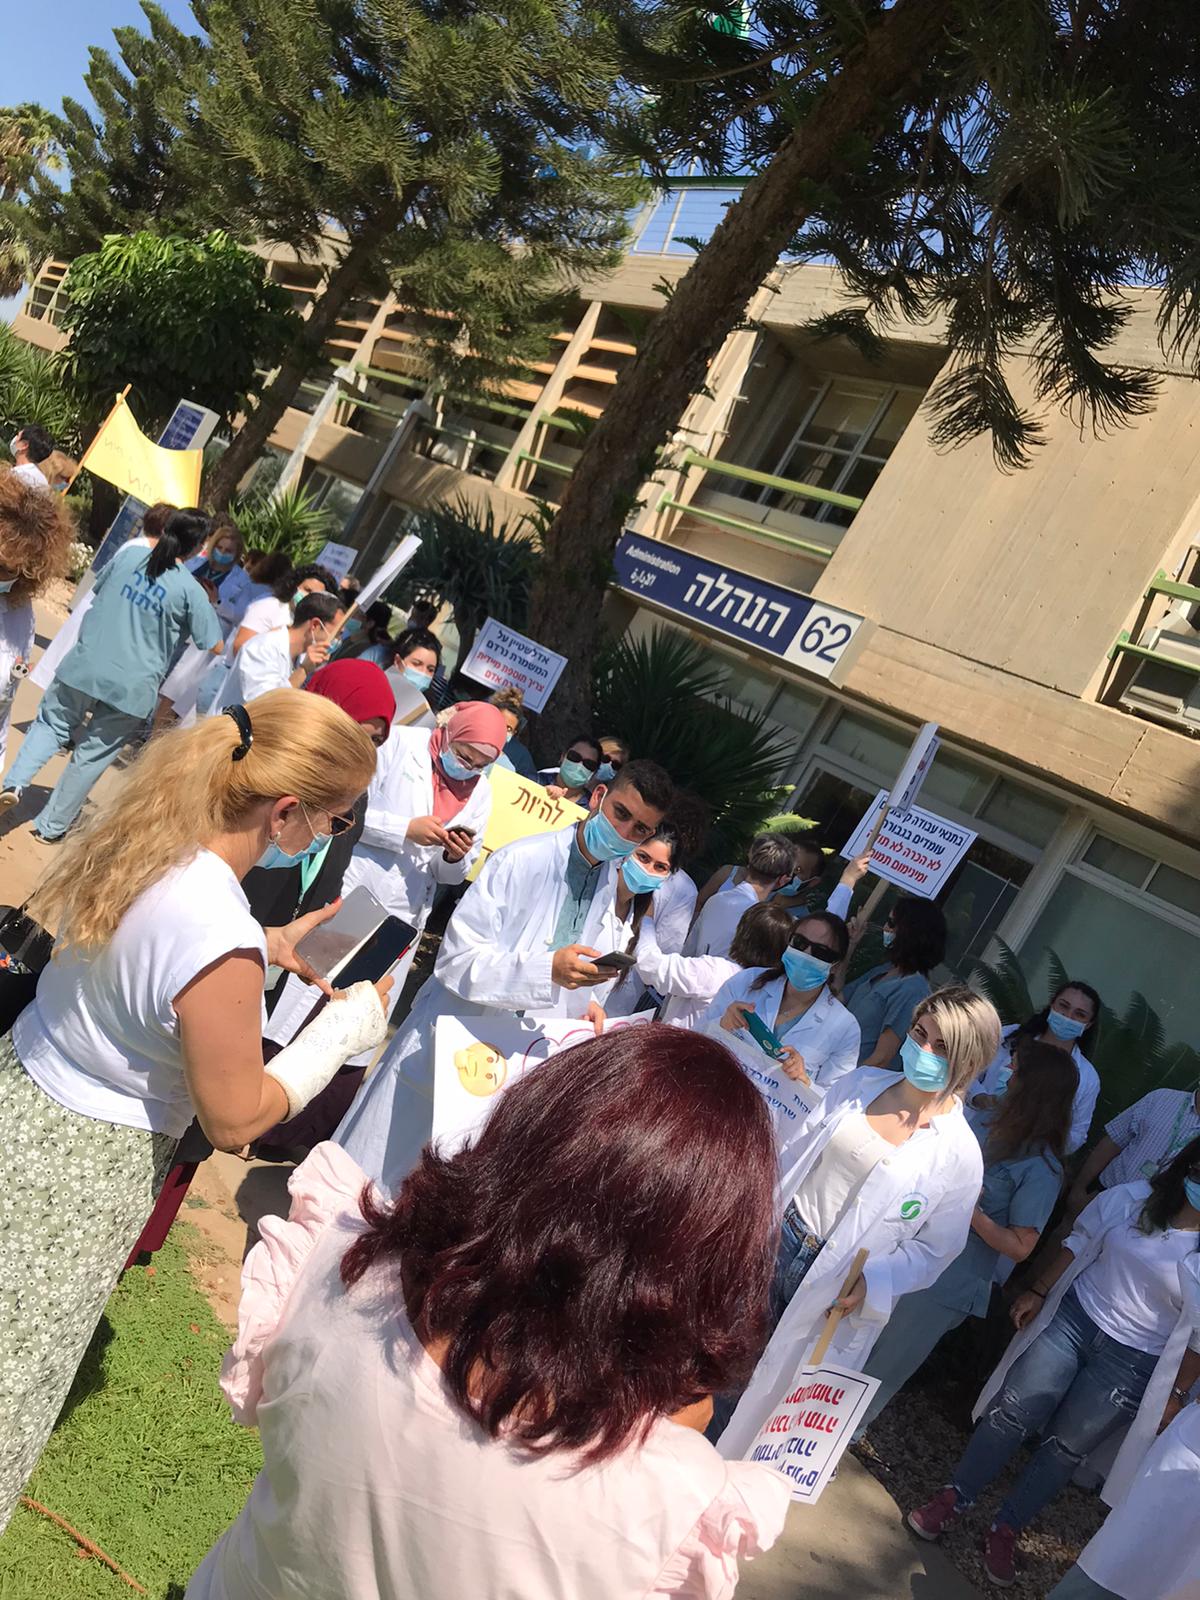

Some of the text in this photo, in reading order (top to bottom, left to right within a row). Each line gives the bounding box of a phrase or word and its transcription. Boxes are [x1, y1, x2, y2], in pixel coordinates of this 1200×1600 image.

[626, 545, 681, 575] Administration
[133, 571, 166, 600] חר
[684, 573, 791, 638] הנהלה
[497, 630, 550, 664] אדלשטיין על
[800, 616, 851, 663] 62
[486, 640, 548, 678] המשמרת נרדם
[485, 670, 503, 684] אדם
[502, 665, 528, 684] תוספת
[528, 678, 544, 692] צריך
[511, 787, 564, 825] להיות
[911, 816, 938, 834] עבודה
[889, 841, 903, 852] לא
[912, 834, 945, 855] עומדים
[939, 828, 963, 846] בתנאי
[870, 848, 928, 883] ומינימום תמור
[902, 848, 927, 865] הכרה
[926, 860, 941, 871] לא
[804, 1411, 839, 1434] תודה
